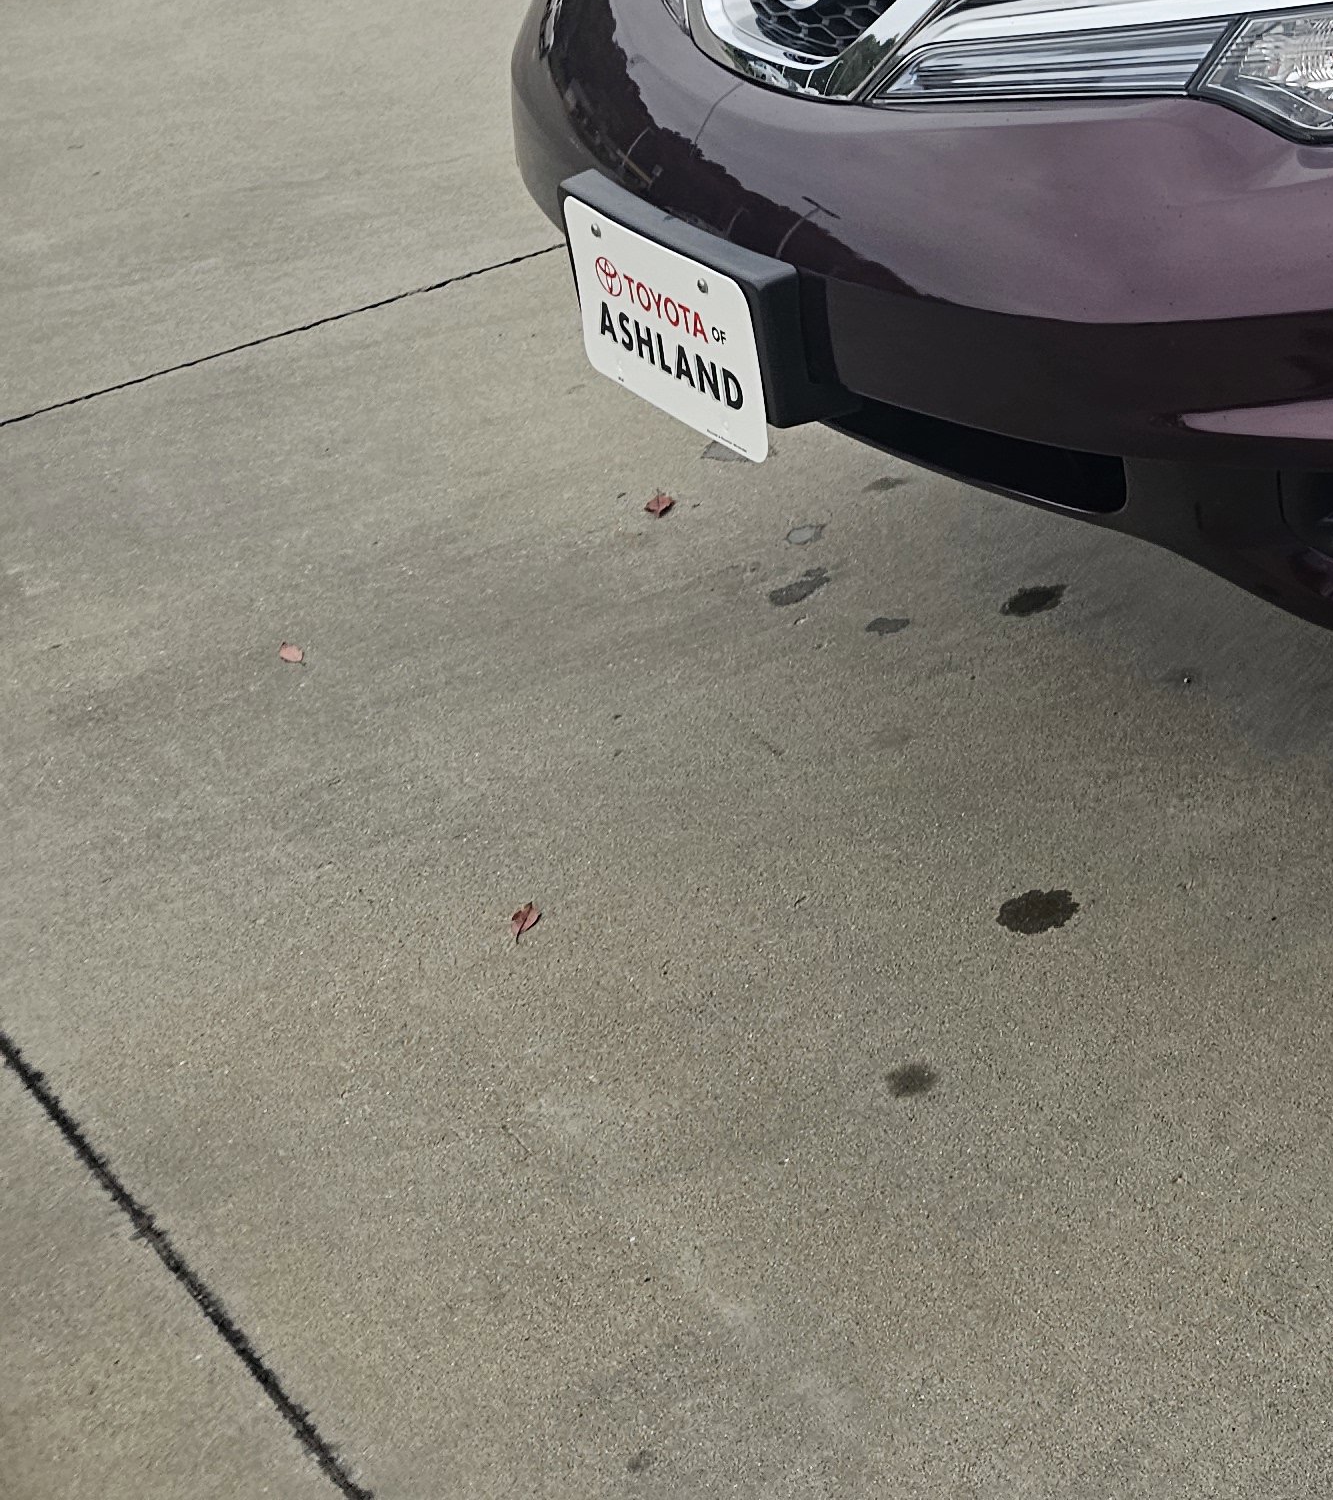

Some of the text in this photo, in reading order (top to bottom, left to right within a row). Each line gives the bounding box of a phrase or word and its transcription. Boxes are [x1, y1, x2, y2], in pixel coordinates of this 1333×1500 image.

[623, 273, 727, 344] TOYOTA OF
[600, 301, 744, 411] ASHLAND
